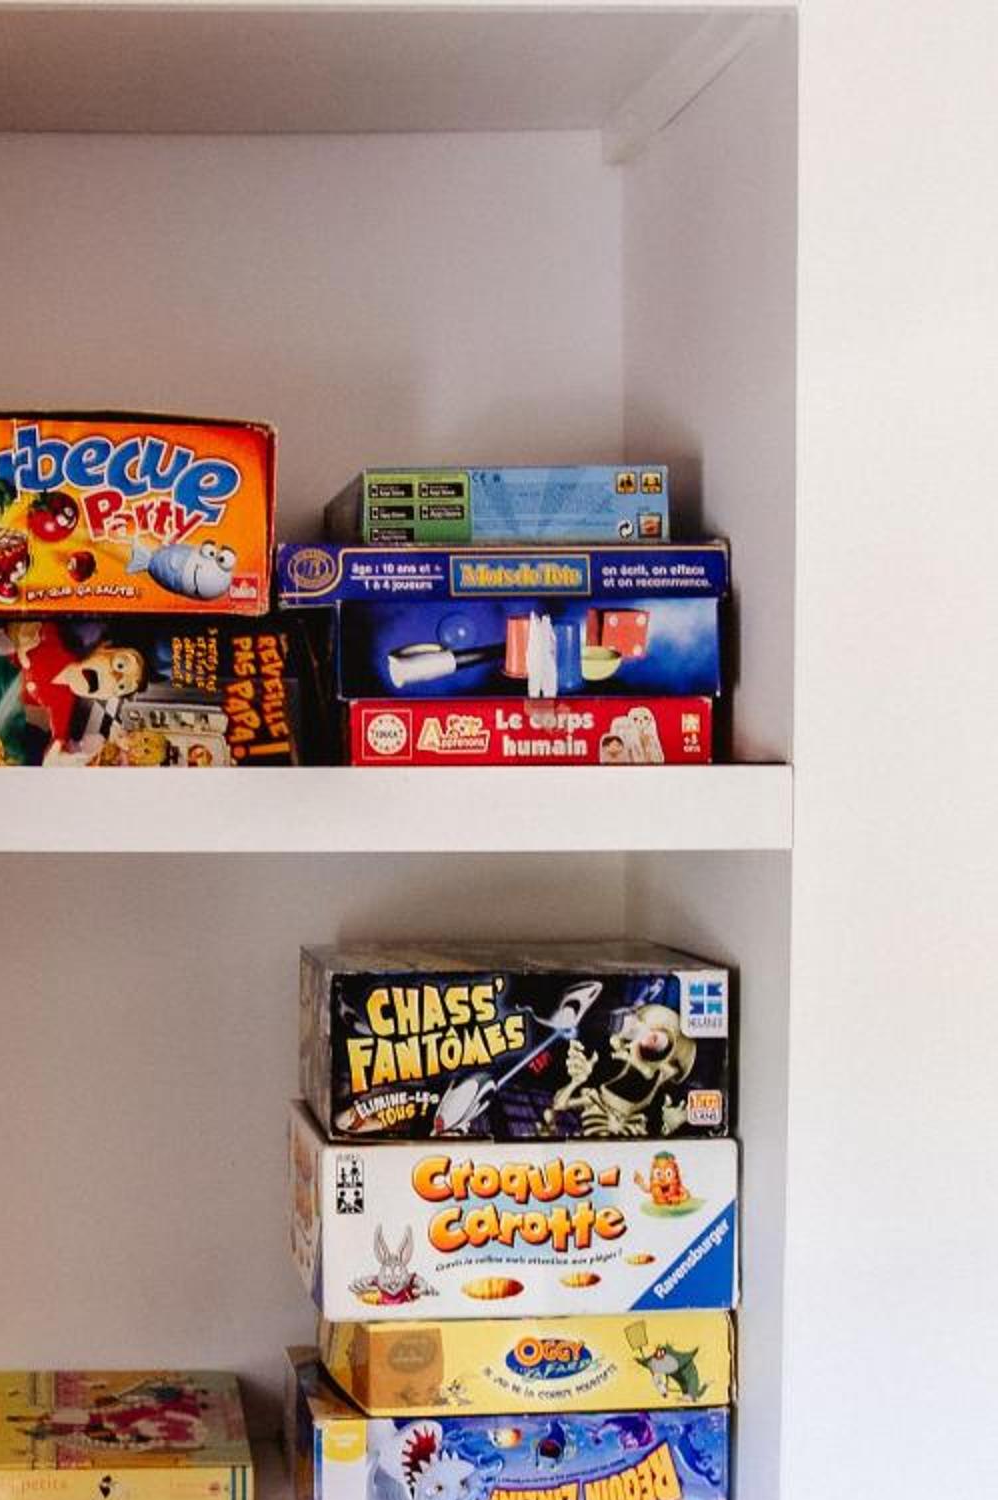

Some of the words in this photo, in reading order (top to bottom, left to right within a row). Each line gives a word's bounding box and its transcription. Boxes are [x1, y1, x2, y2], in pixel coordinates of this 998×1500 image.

[82, 490, 202, 544] Party
[383, 564, 394, 573] 10
[397, 565, 416, 573] ans
[420, 564, 430, 573] et
[602, 566, 616, 575] on
[652, 566, 667, 575] on
[670, 564, 705, 575] efface
[364, 581, 369, 590] 1
[392, 580, 433, 592] joueurs
[603, 578, 615, 587] et
[617, 579, 633, 587] on
[233, 636, 257, 676] PAS
[224, 680, 261, 743] PAPA
[495, 709, 522, 730] Le
[503, 736, 587, 757] humain
[367, 978, 505, 1037] CHASS'
[347, 1016, 526, 1095] FANTÔMES
[377, 1103, 415, 1126] TOUS
[653, 1217, 730, 1300] Ravensburger
[514, 1335, 583, 1367] OGGY
